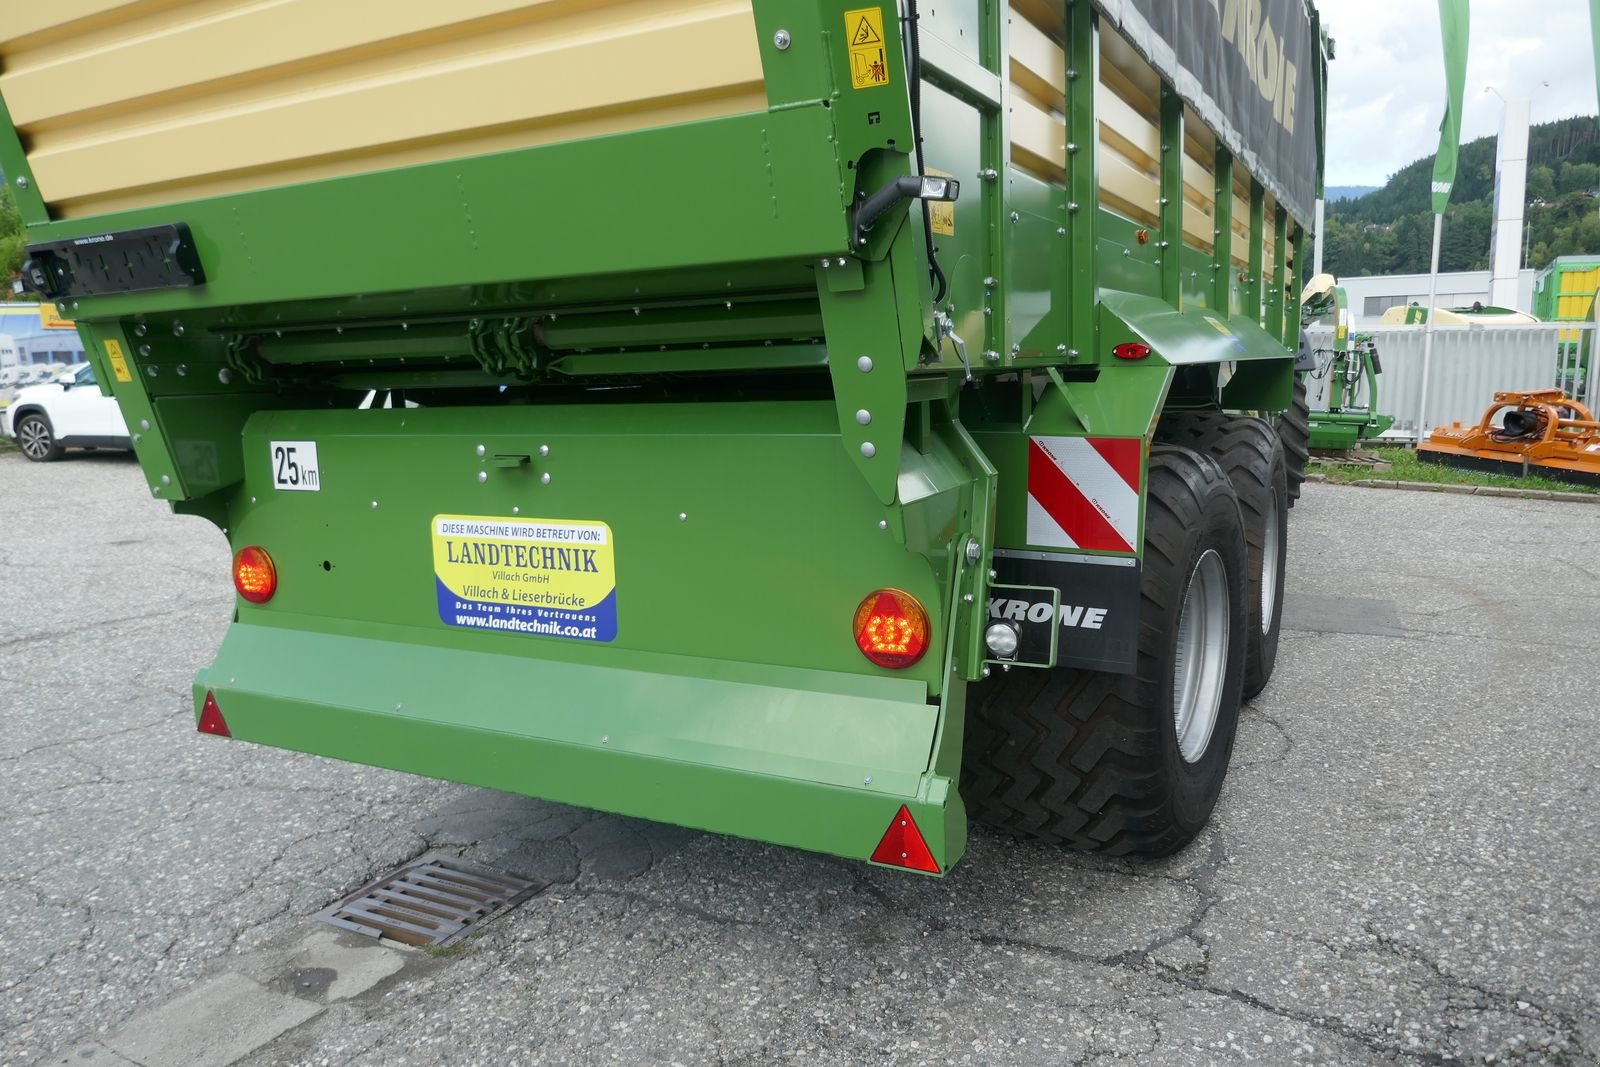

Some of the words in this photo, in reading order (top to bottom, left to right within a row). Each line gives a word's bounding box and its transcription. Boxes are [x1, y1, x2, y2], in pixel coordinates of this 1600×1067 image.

[275, 446, 300, 486] 25
[301, 465, 318, 486] km
[442, 523, 465, 534] DIESE
[466, 524, 510, 536] MASCHINE
[511, 527, 534, 538] WIRD
[536, 528, 576, 541] BETREUT
[577, 530, 601, 541] VON:
[446, 541, 599, 573] LANDTECHNIK
[492, 570, 520, 583] Villach
[522, 573, 550, 584] GmbH
[462, 585, 499, 600] Villach
[501, 588, 510, 600] &
[512, 589, 585, 607] Lieserbrücke
[455, 601, 473, 611] Das
[476, 603, 502, 613] Team
[506, 605, 533, 616] Ihres
[537, 609, 597, 622] Vertrauens
[989, 598, 1108, 630] KRONE
[456, 614, 597, 639] www.landtechnik.co.at
